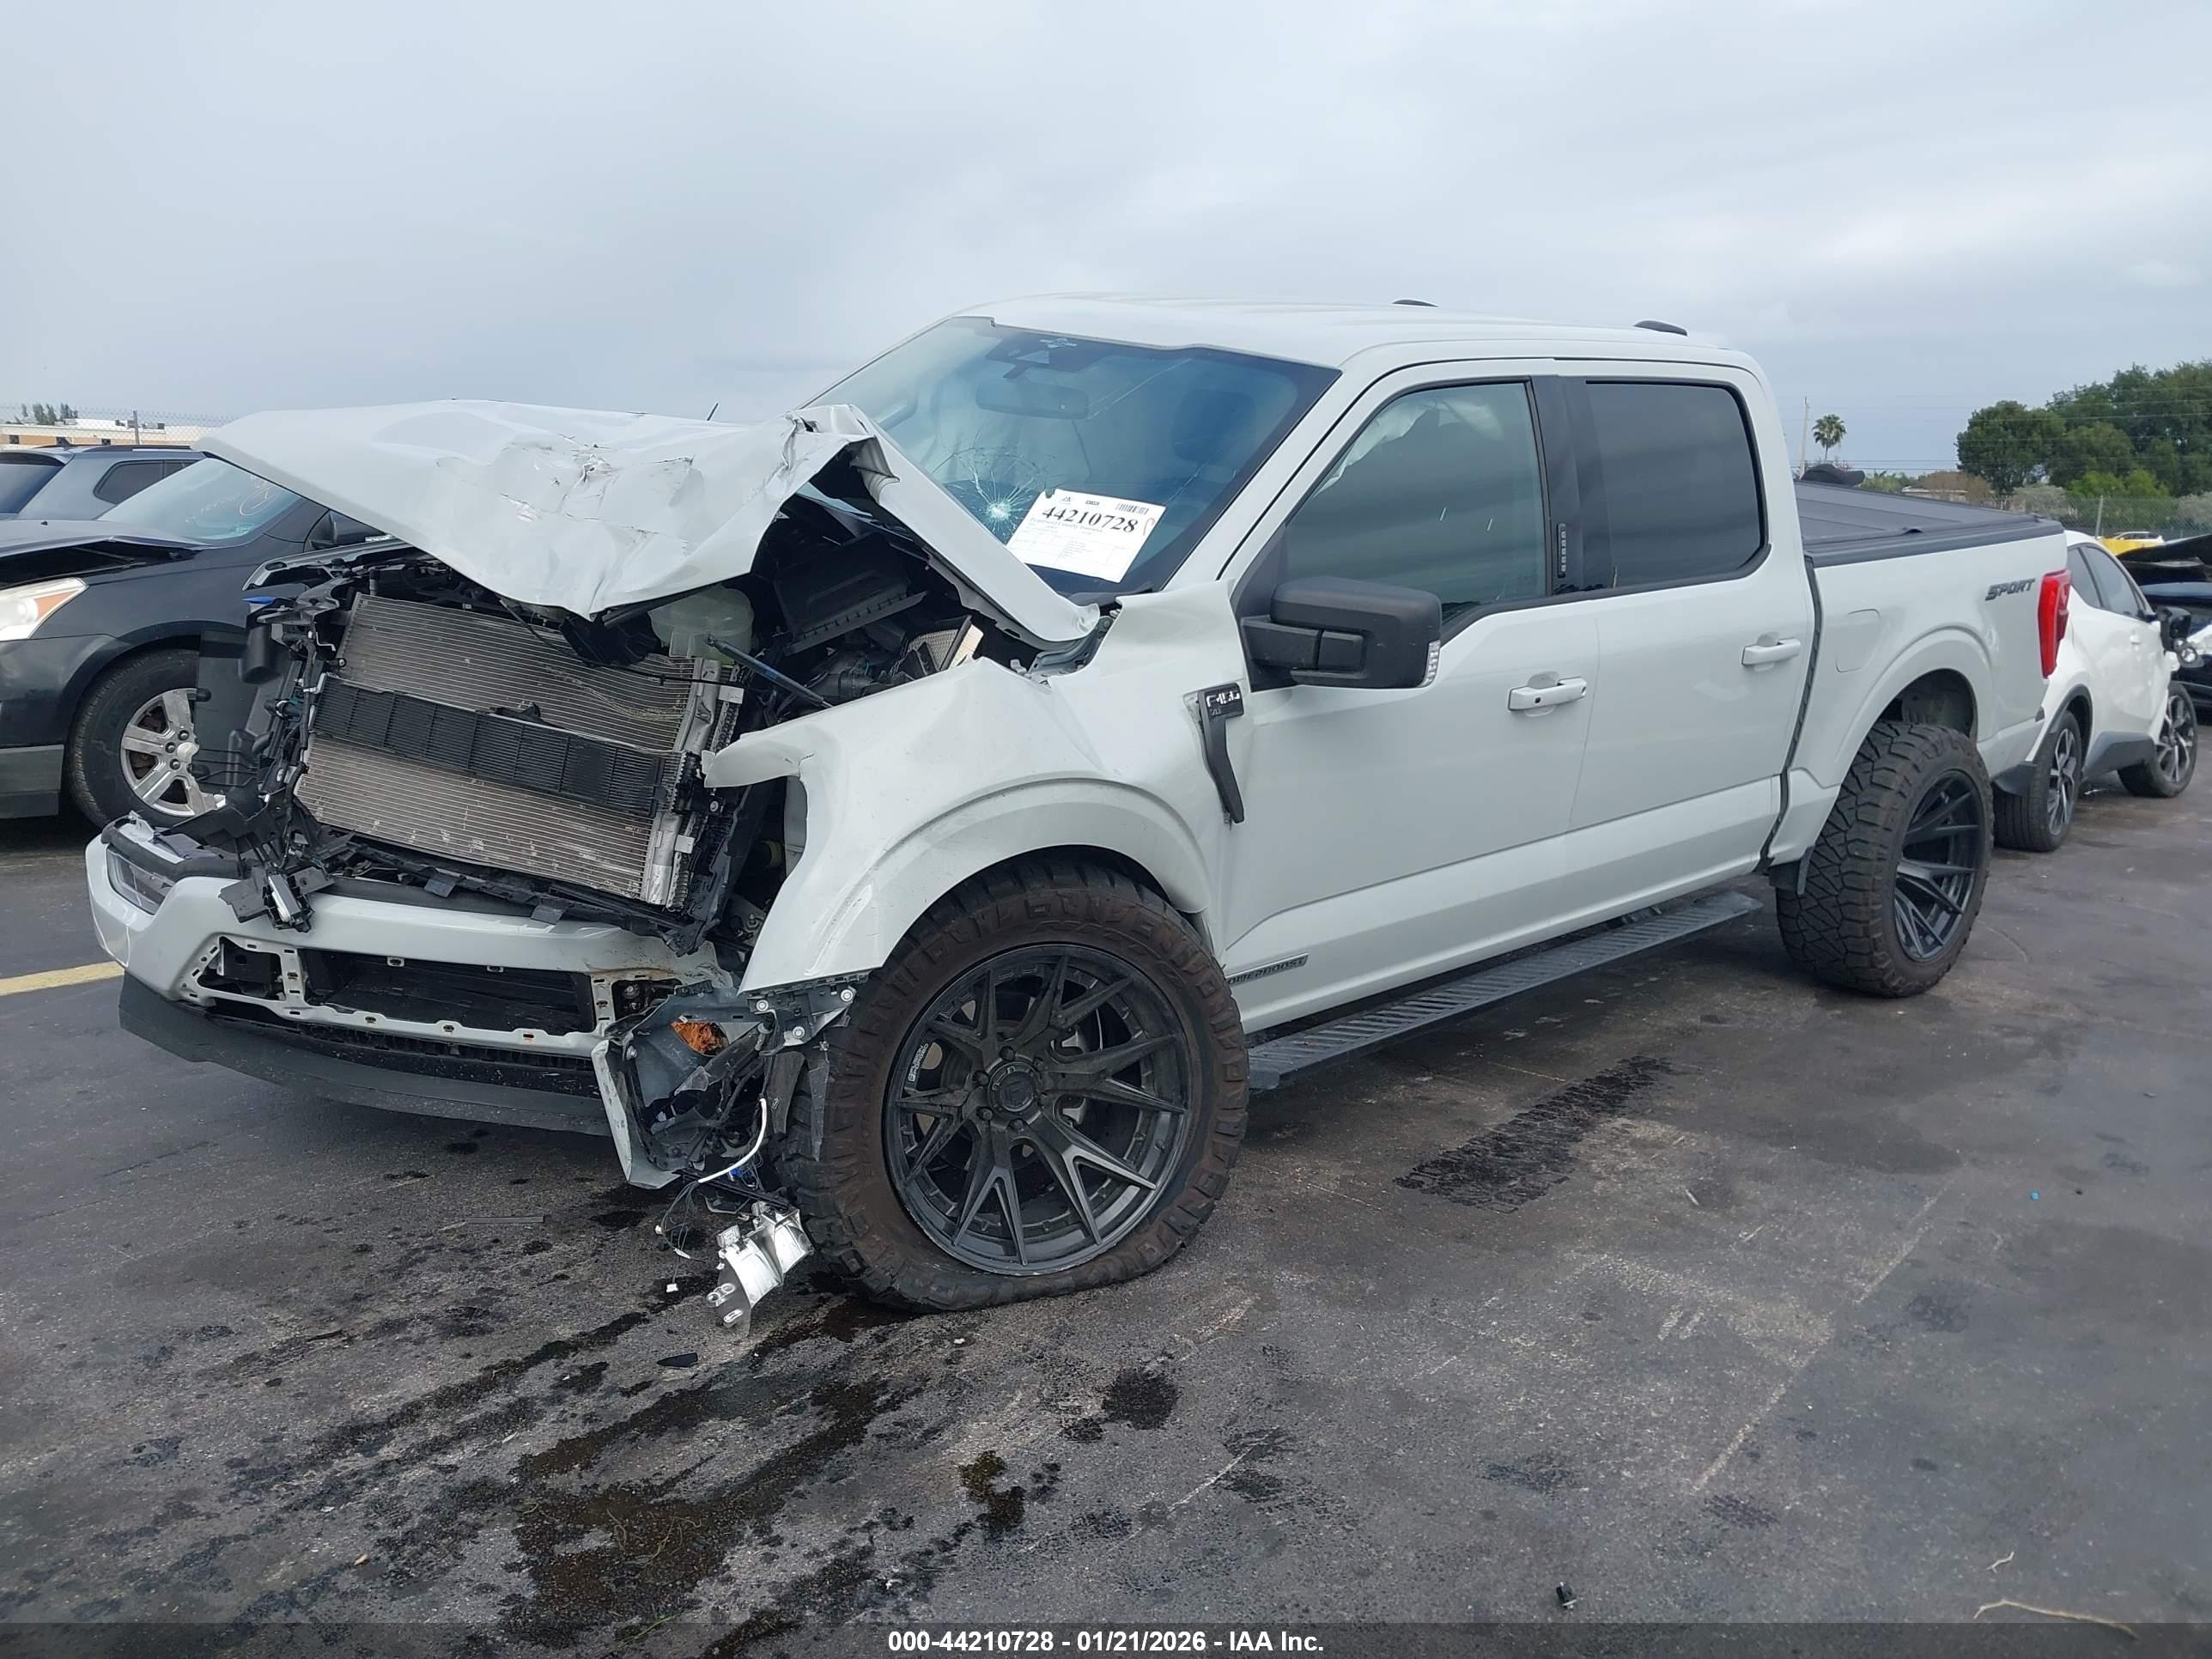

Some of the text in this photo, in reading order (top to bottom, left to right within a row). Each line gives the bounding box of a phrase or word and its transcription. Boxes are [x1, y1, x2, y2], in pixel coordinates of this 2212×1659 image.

[1042, 506, 1139, 533] 44210728
[1984, 578, 2035, 601] SPORT
[1227, 956, 1308, 986] OWERBOOST
